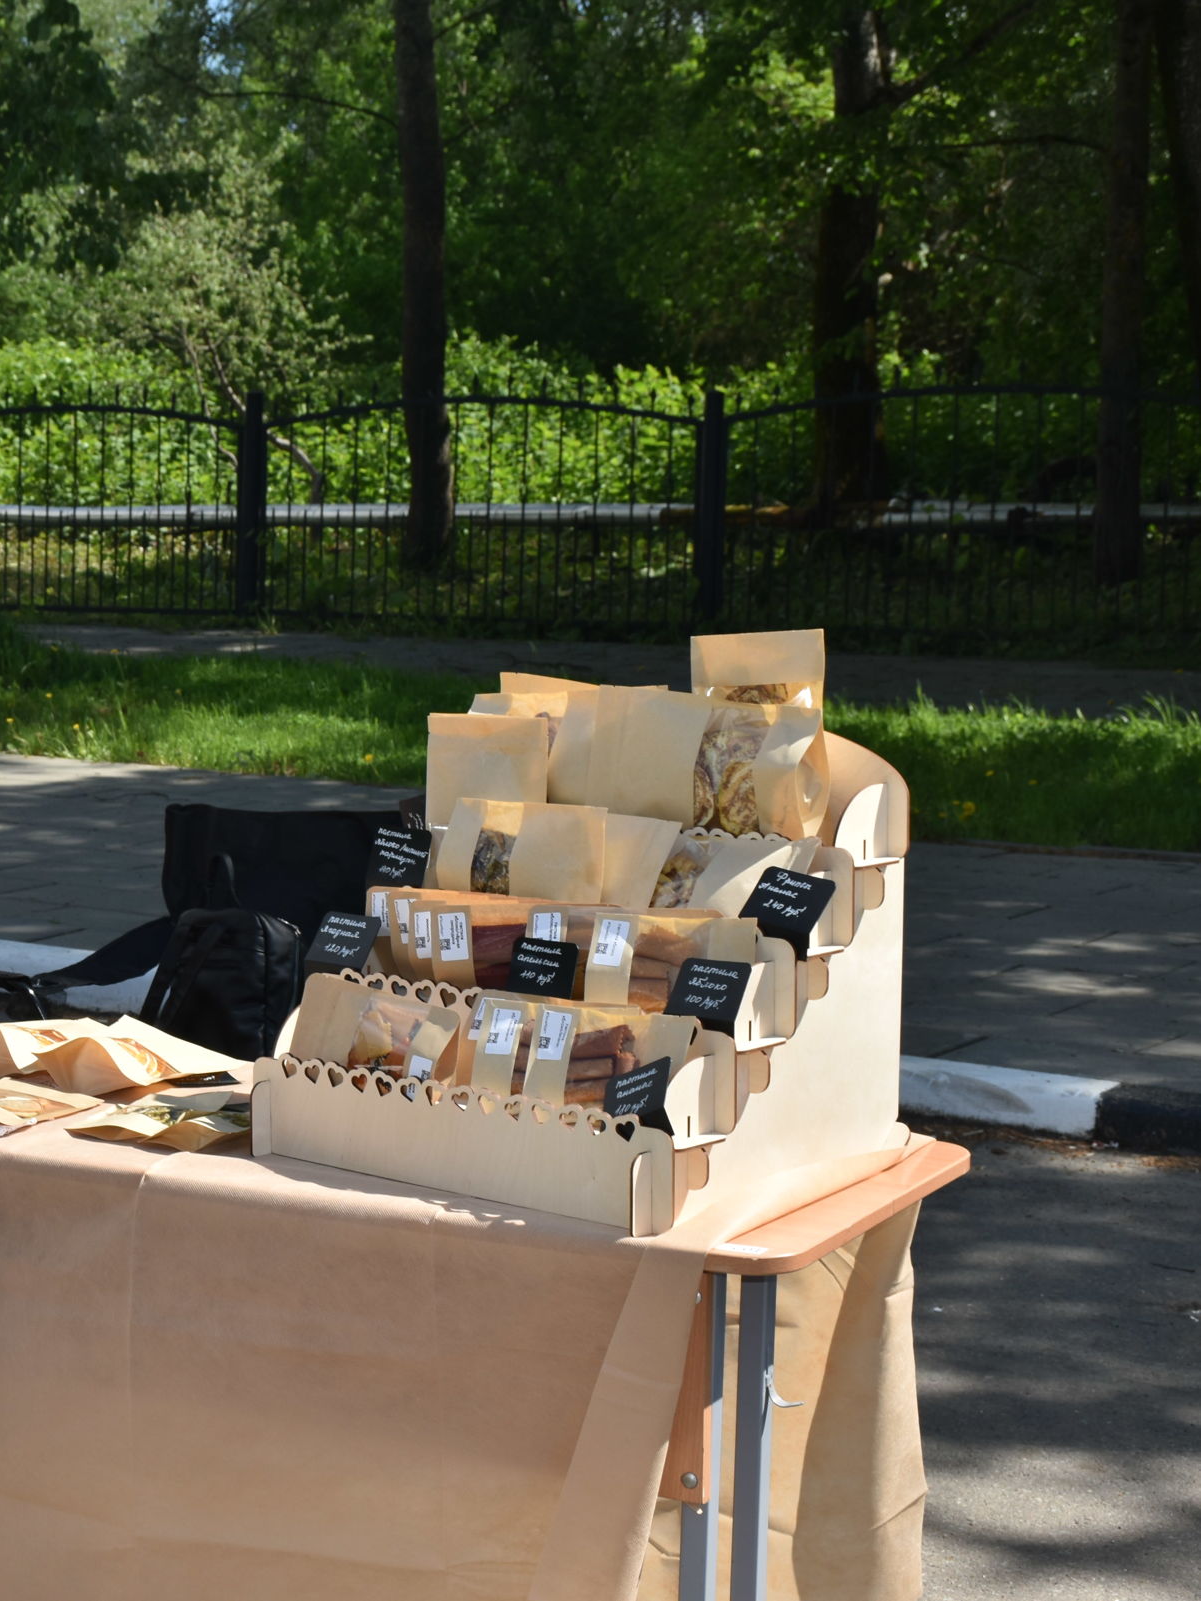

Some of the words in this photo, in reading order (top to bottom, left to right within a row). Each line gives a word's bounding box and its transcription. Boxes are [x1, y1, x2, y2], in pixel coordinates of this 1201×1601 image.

[328, 916, 367, 928] пастила
[521, 942, 562, 955] пастила
[517, 954, 559, 968] апельсин
[691, 965, 739, 979] пастила
[685, 994, 703, 1004] 100
[616, 1068, 659, 1089] пастила
